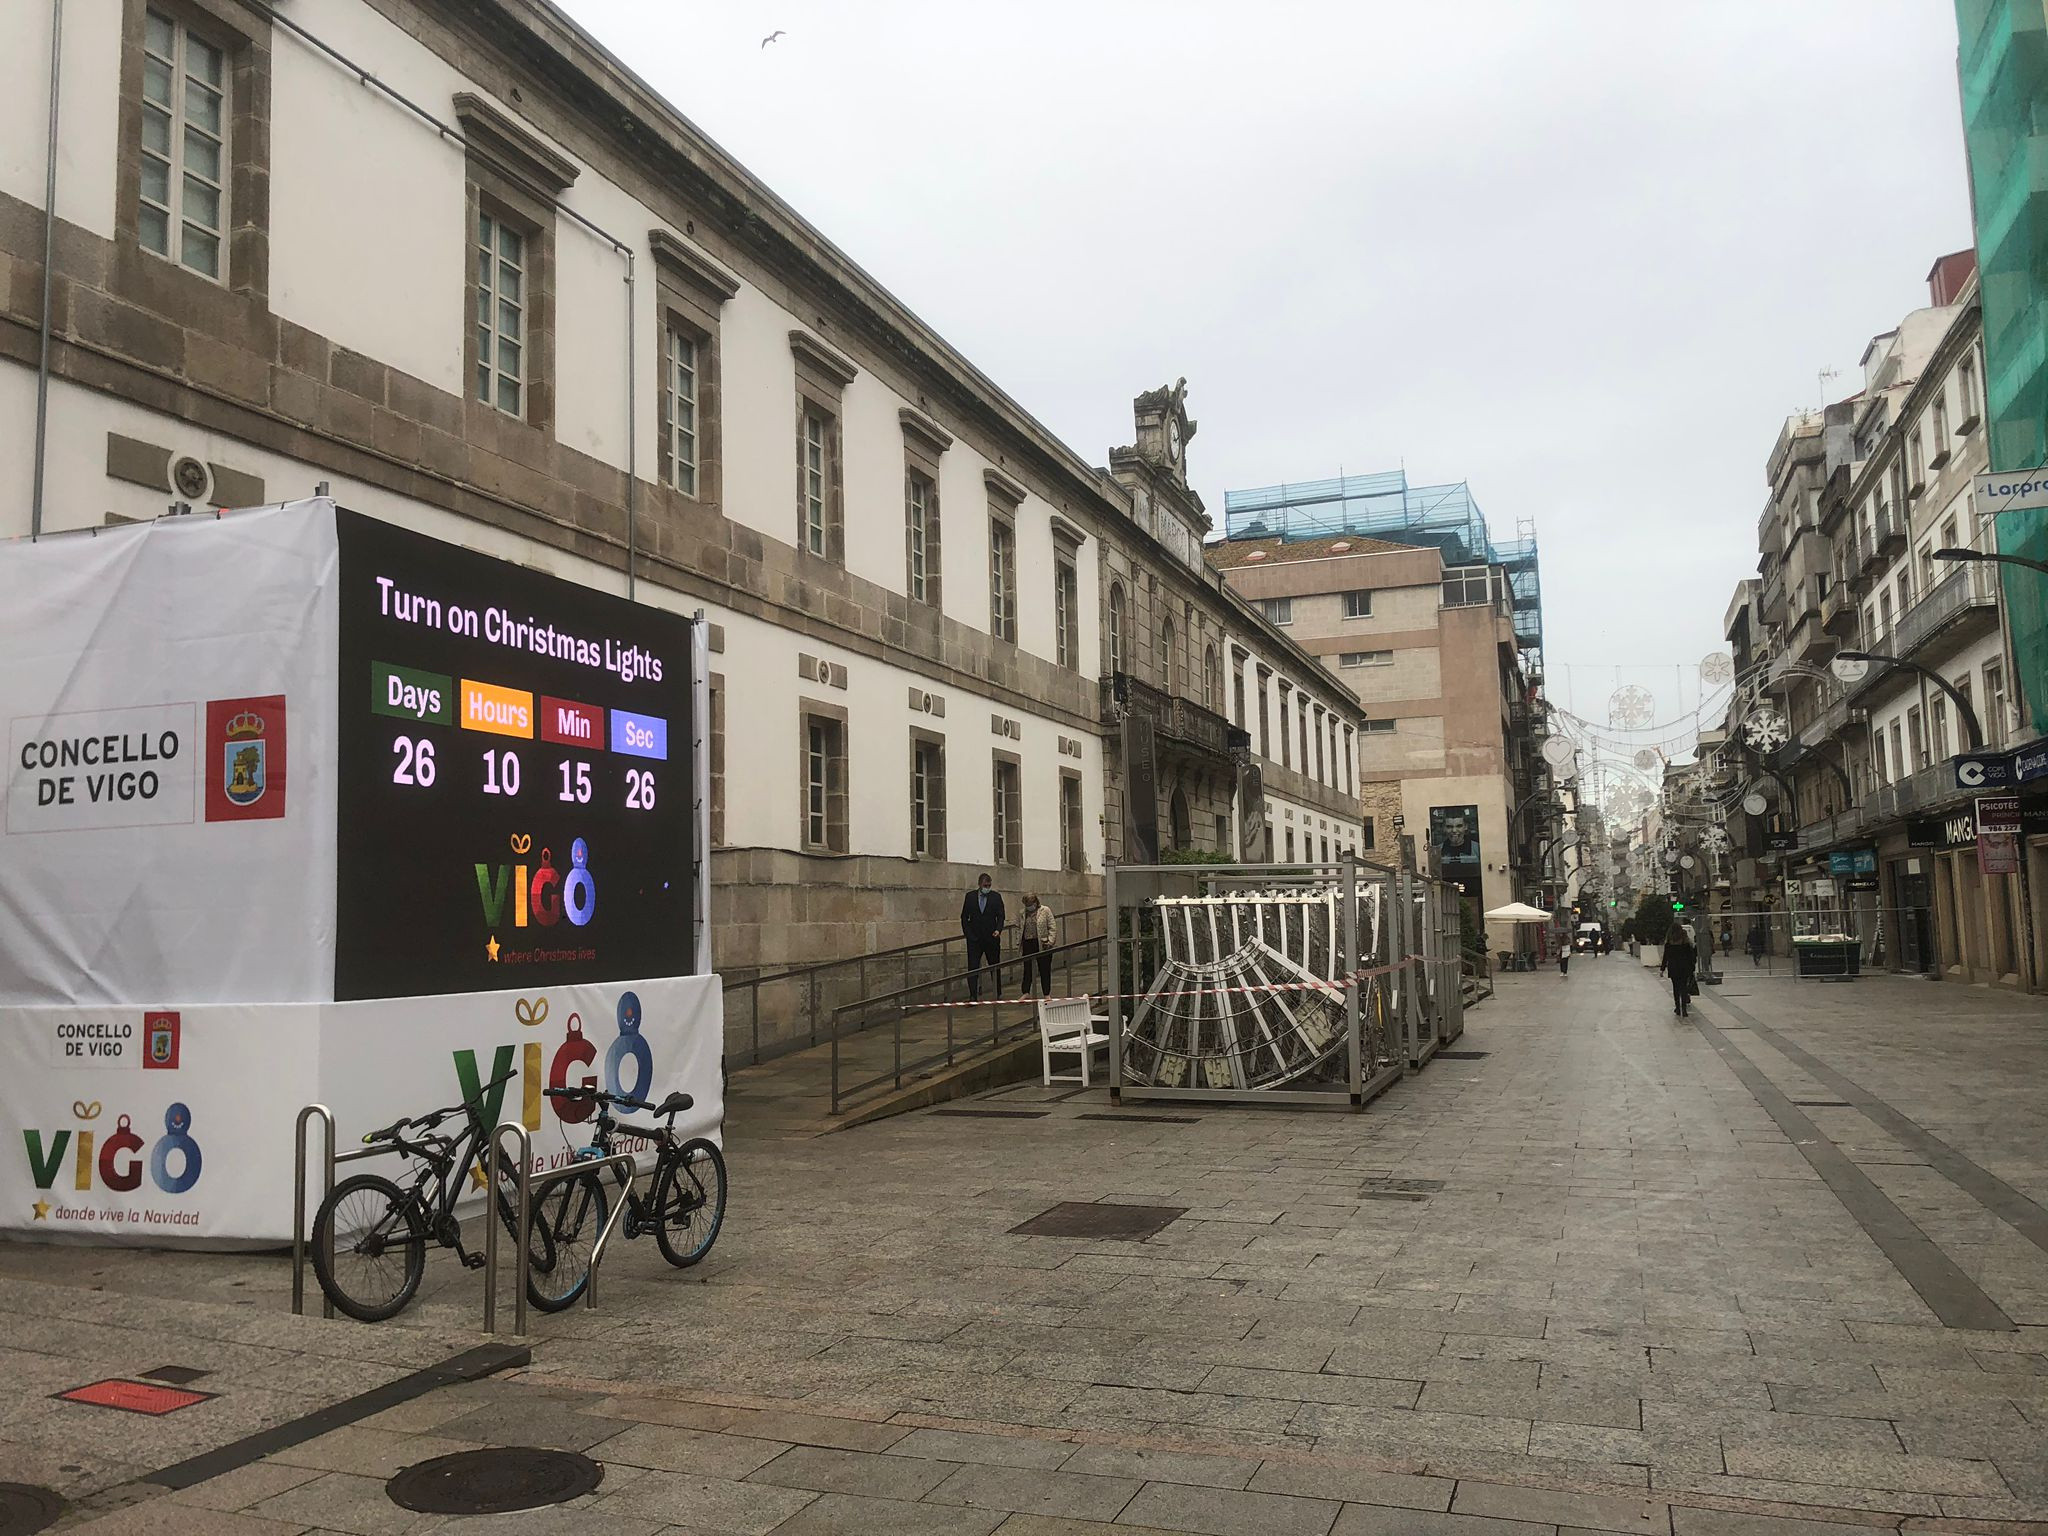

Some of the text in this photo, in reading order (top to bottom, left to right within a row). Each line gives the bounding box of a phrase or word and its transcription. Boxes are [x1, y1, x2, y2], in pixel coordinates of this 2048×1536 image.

[376, 576, 663, 683] Turn on Christmas Lights
[388, 674, 441, 718] Days
[469, 691, 529, 728] Hours
[558, 707, 591, 739] Min
[625, 720, 654, 749] Sec
[21, 730, 179, 770] CONCELLO
[393, 735, 436, 788] 26
[38, 770, 159, 807] DE VIGO
[483, 749, 520, 796] 10
[559, 759, 592, 804] 15
[625, 768, 655, 810] 26
[503, 947, 596, 964] where Christmas lives
[57, 1024, 132, 1039] CONCELLO
[65, 1043, 123, 1057] DE VIGO
[551, 1146, 578, 1170] viv
[56, 1205, 200, 1226] donde vive la Navidad
